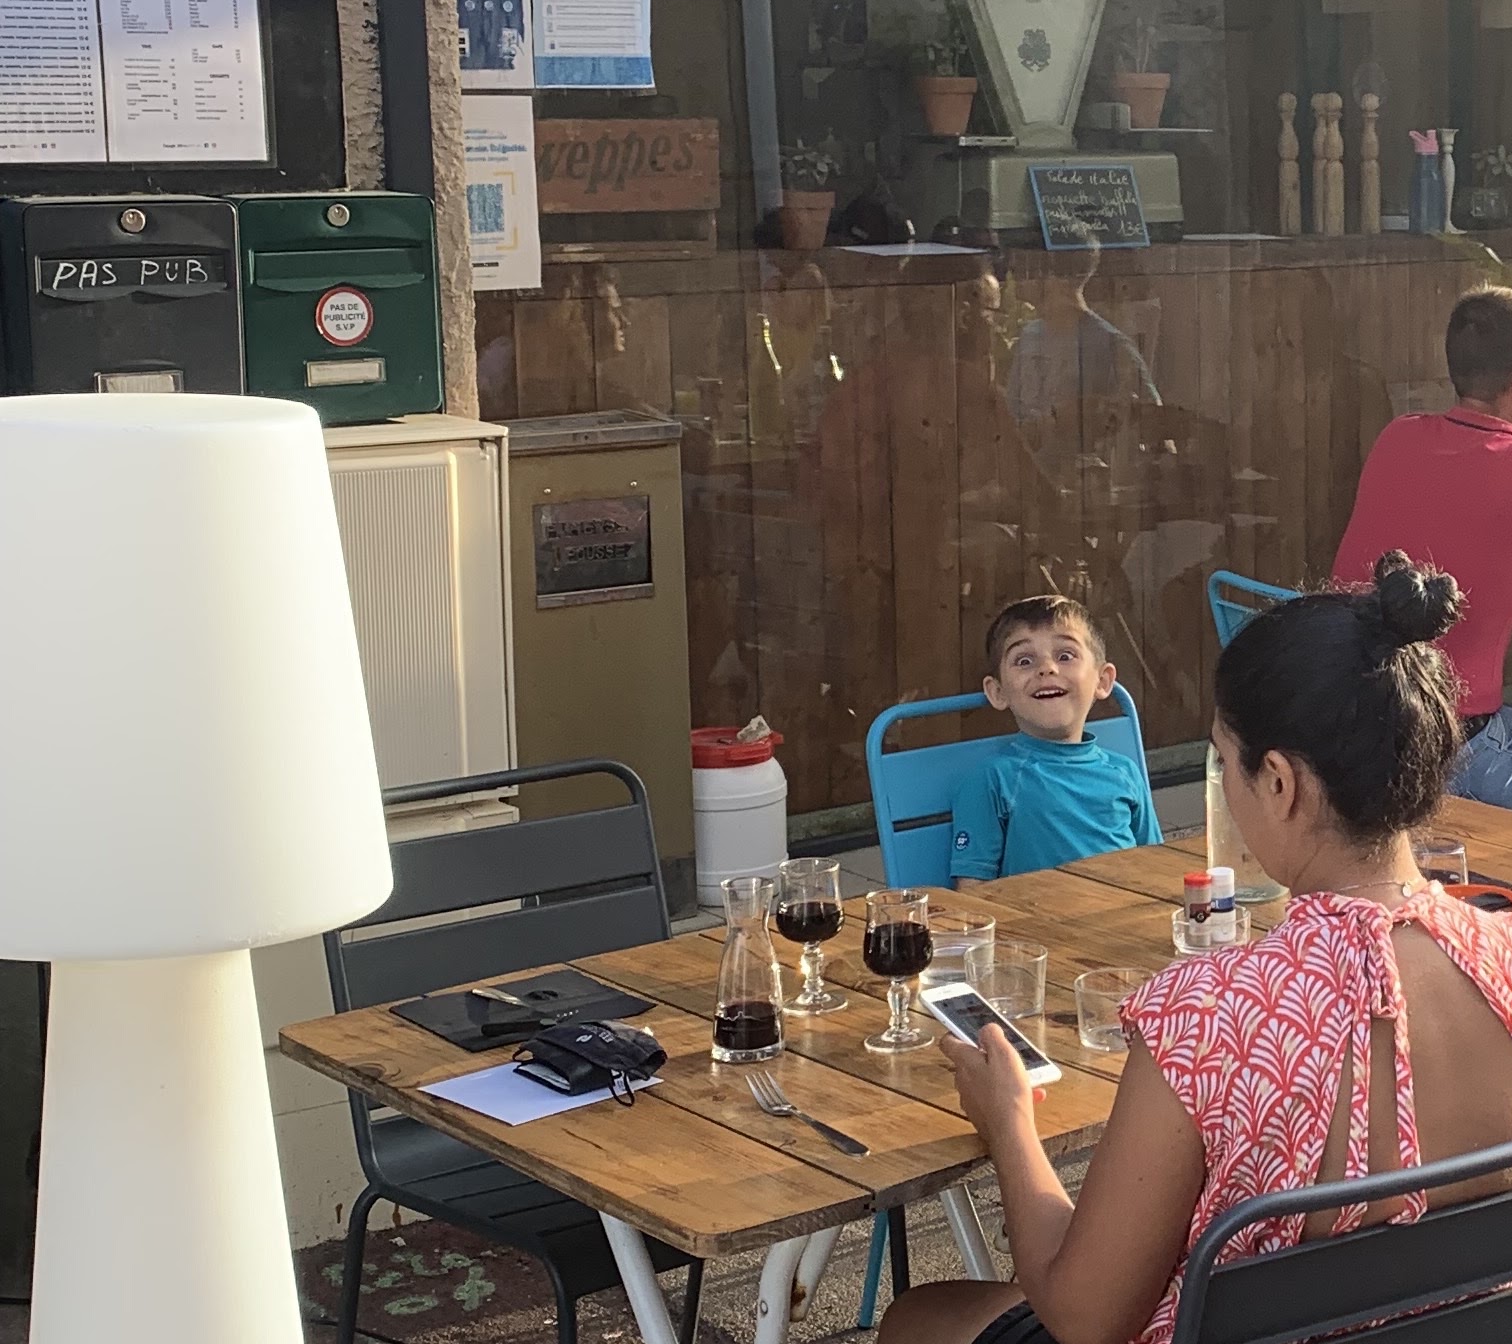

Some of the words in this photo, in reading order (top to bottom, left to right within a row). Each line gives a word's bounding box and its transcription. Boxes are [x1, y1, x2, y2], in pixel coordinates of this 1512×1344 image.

[52, 260, 119, 290] PAS
[140, 259, 208, 286] PUB
[329, 303, 346, 312] PAS
[348, 303, 359, 311] DE
[323, 312, 366, 322] PUBLICITÉ
